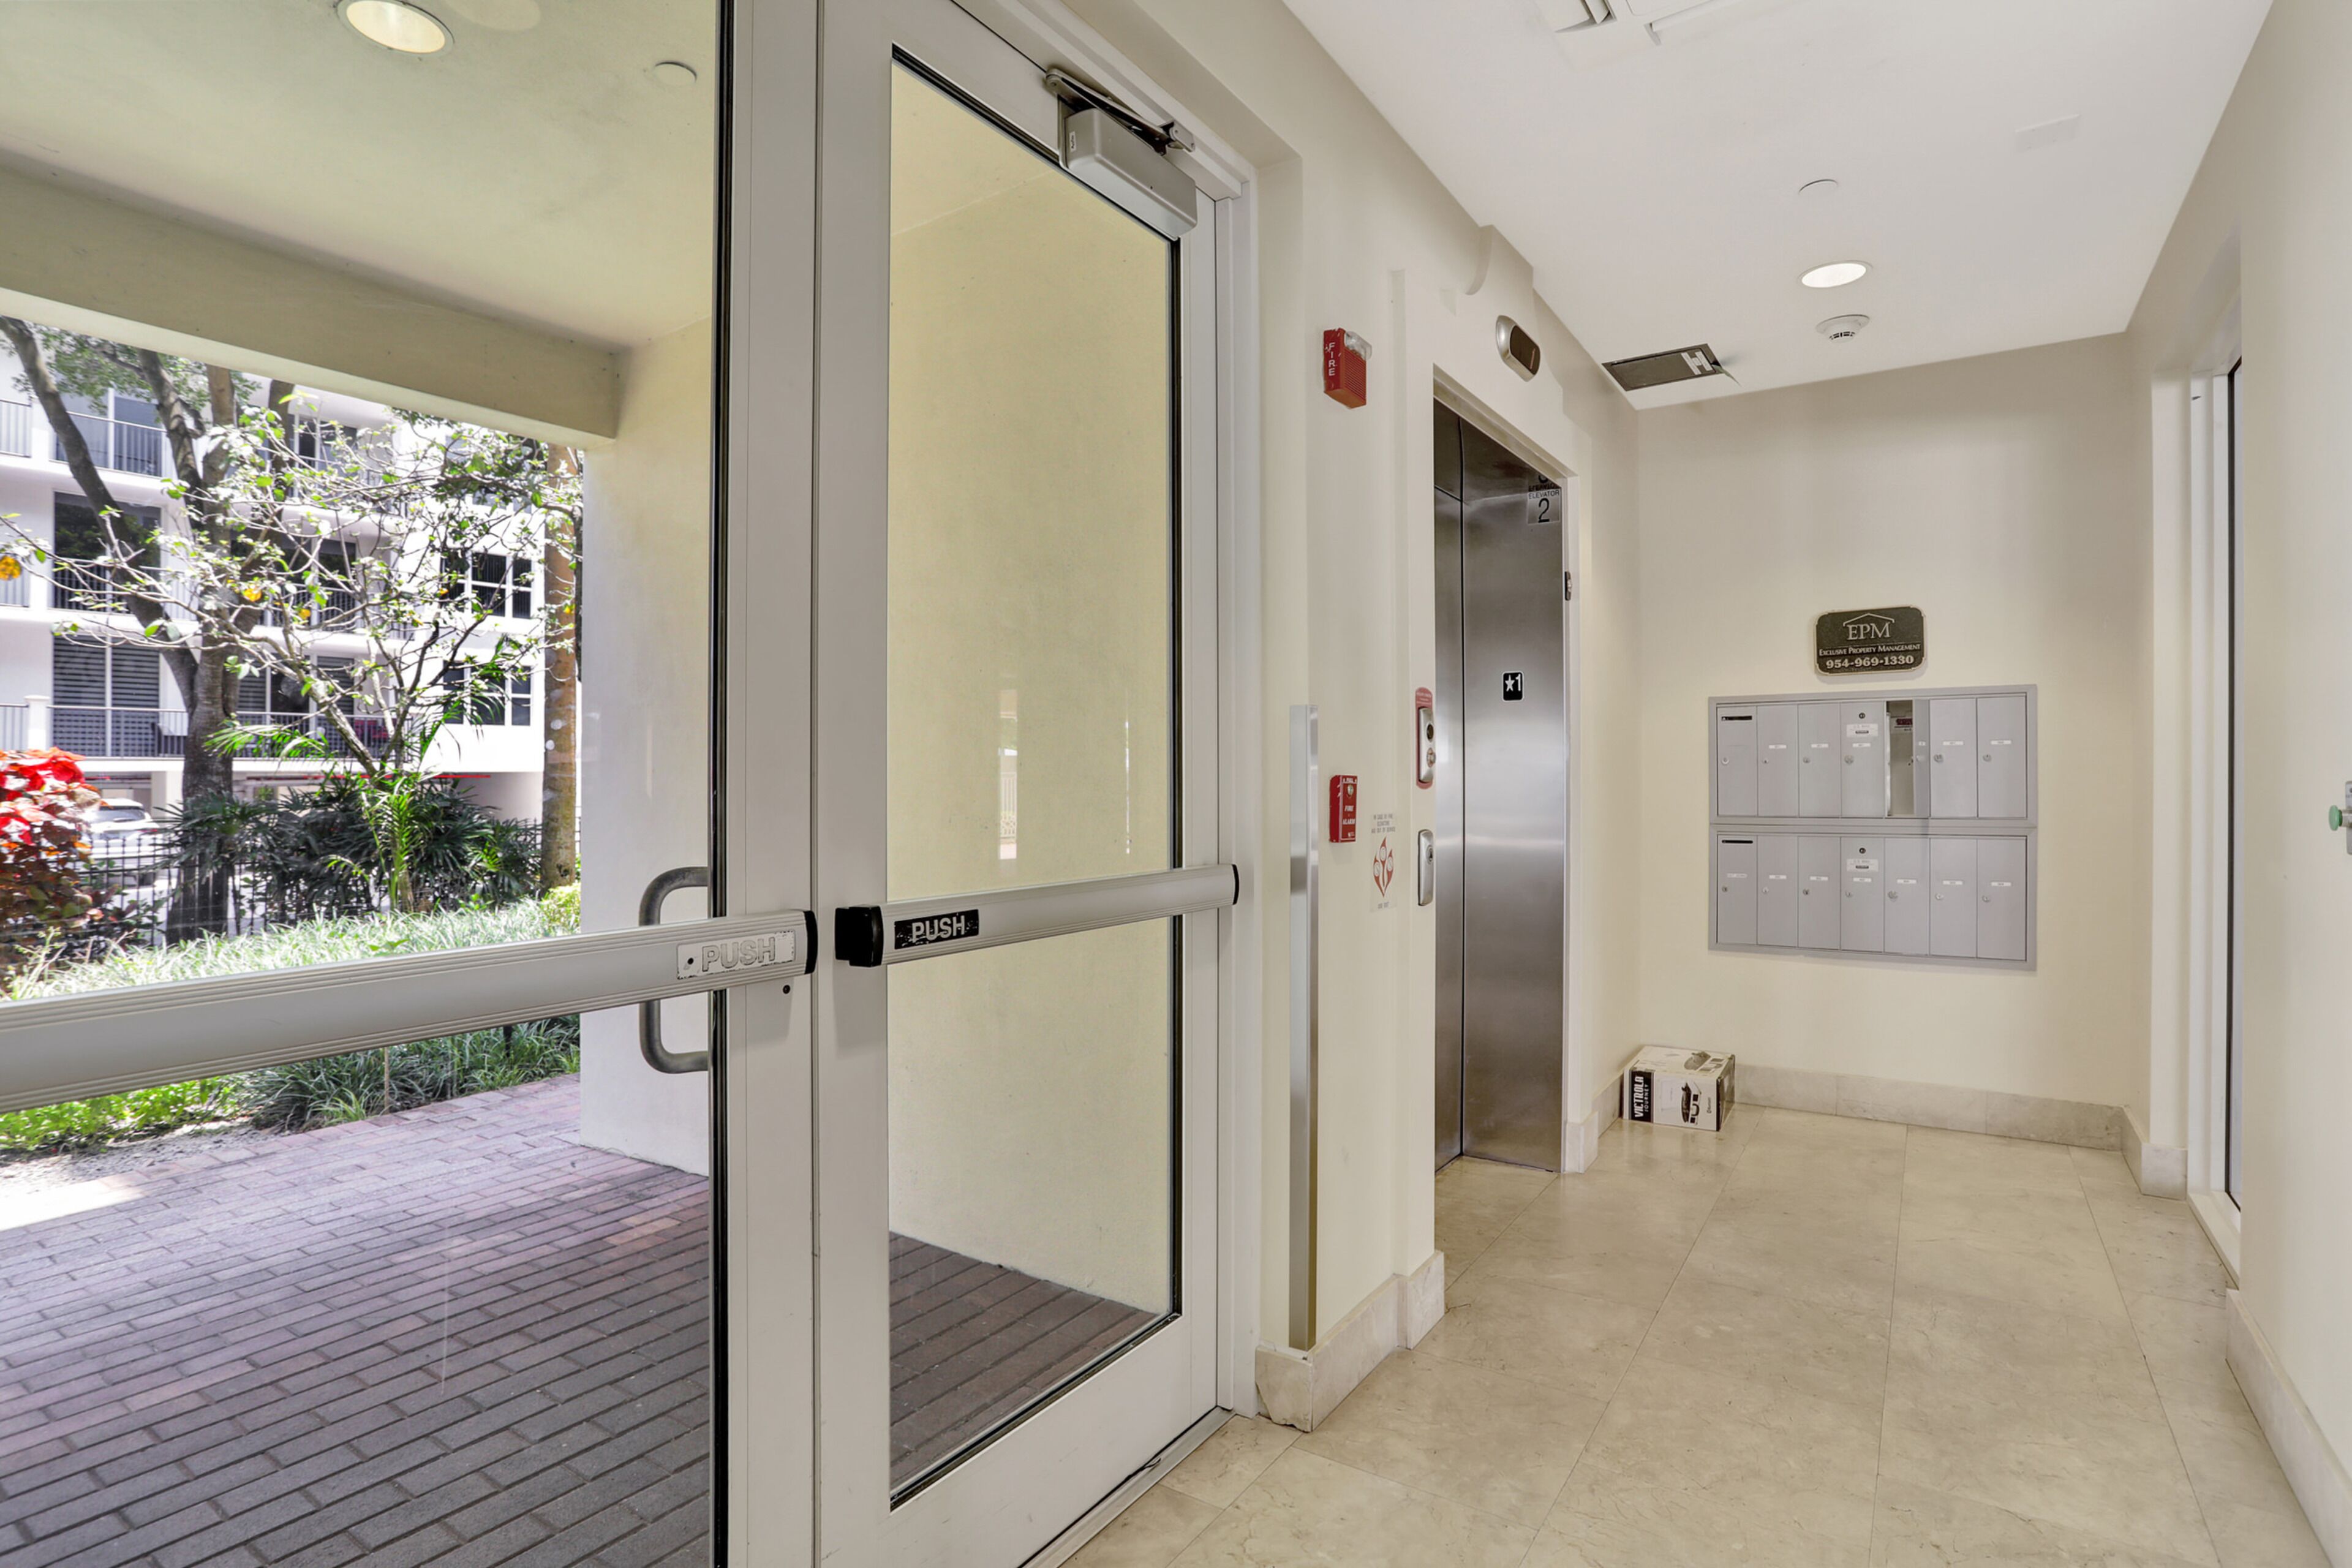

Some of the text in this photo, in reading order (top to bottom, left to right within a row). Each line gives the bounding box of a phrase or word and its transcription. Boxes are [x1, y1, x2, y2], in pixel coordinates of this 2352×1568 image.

[1528, 490, 1559, 499] ELEVATOR
[1538, 497, 1550, 523] 2
[1847, 621, 1891, 641] EPM
[1826, 655, 1915, 669] 954-969-1330
[911, 915, 966, 943] PUSH
[701, 936, 776, 972] PUSH
[1634, 1076, 1644, 1118] VICTROLA
